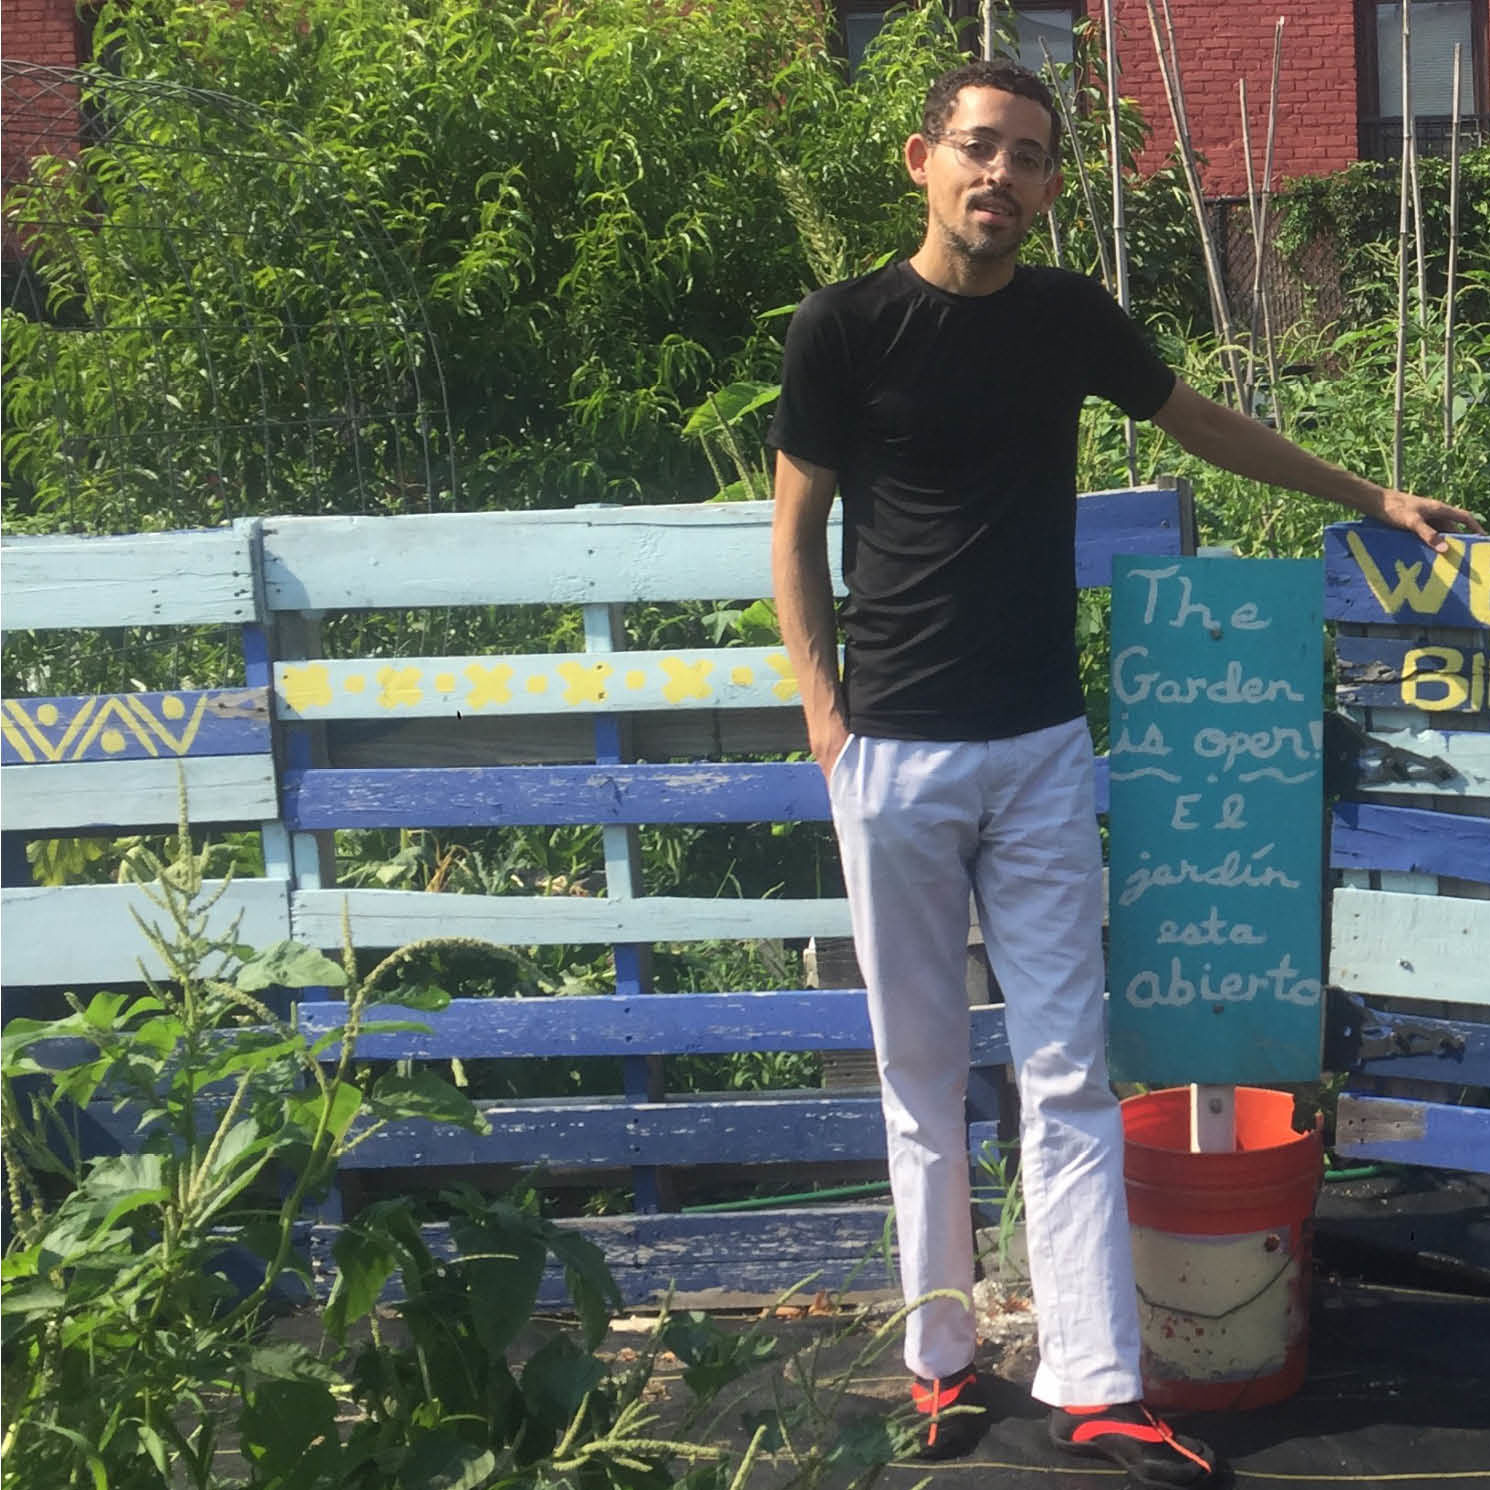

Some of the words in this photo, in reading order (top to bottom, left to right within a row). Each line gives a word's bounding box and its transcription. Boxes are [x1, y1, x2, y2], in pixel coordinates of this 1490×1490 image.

[1128, 564, 1273, 629] The
[1113, 645, 1304, 704] Garden
[1112, 711, 1172, 756] is
[1194, 721, 1323, 772] open!
[1119, 843, 1299, 905] jardín
[1157, 905, 1268, 945] esta
[1126, 953, 1323, 1008] abierto
